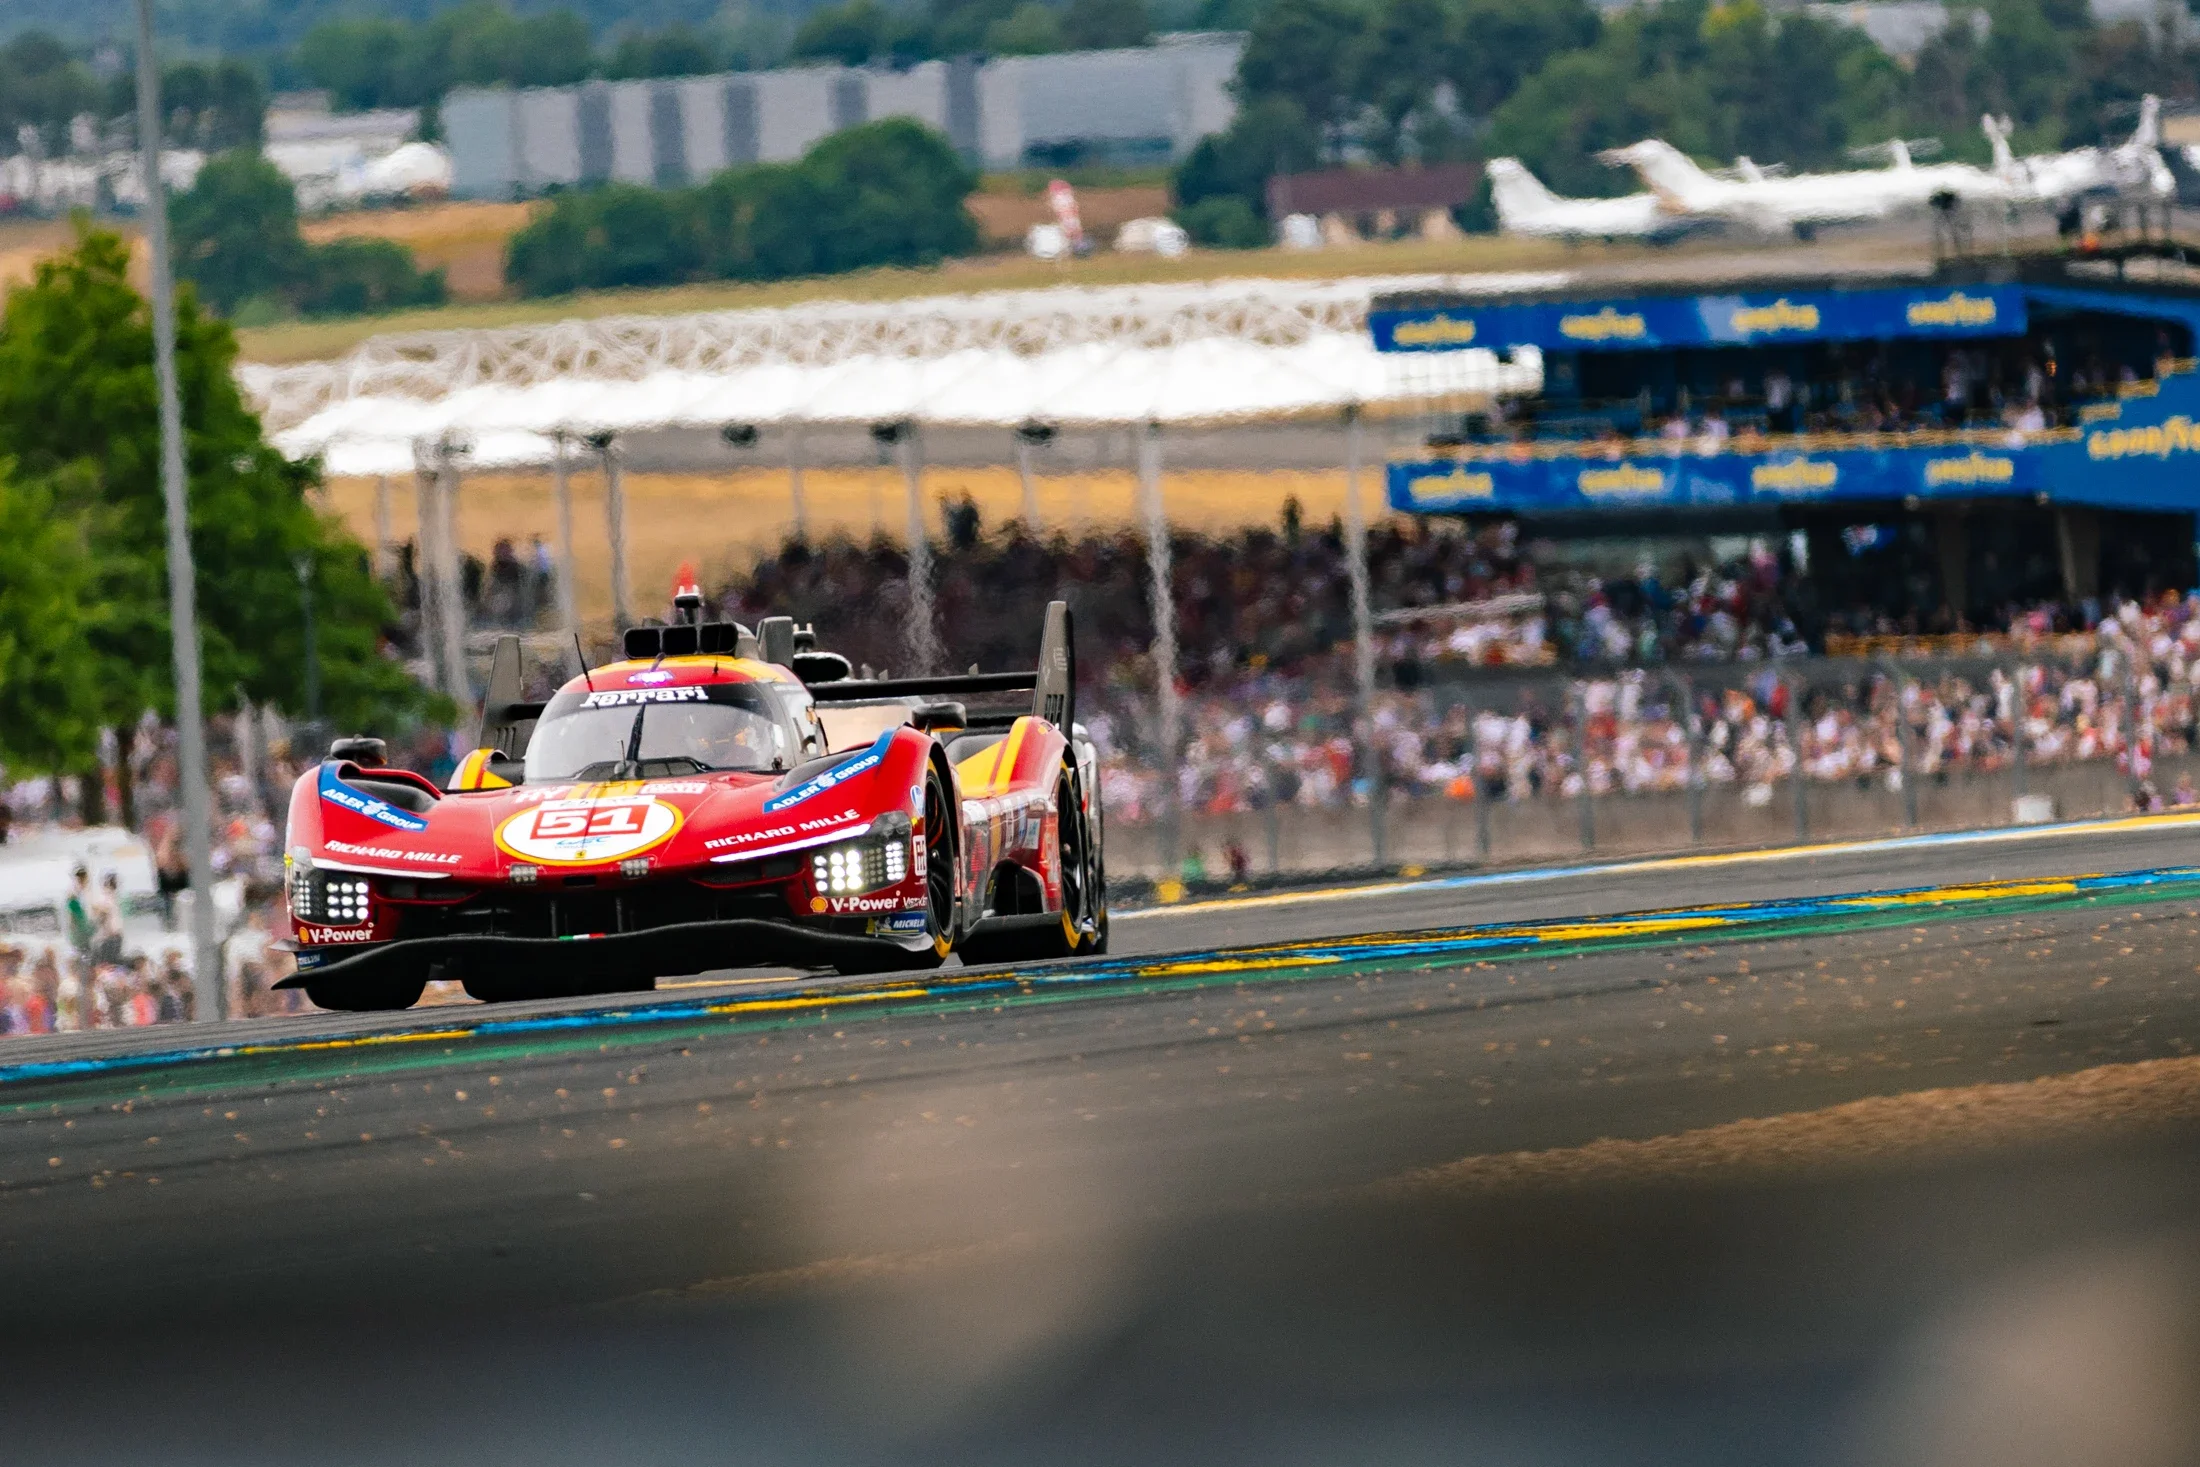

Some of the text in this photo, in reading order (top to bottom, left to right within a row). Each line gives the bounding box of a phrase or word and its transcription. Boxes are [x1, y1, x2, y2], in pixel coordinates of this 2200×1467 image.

[579, 686, 709, 708] Ferrari
[772, 754, 880, 811] ADLER GROUP
[321, 788, 424, 830] ADLER GROUP
[536, 807, 639, 837] 51
[704, 808, 861, 849] RICHARD MILLE
[323, 840, 463, 865] RICHARD MILLE
[830, 896, 899, 912] V-Power
[309, 927, 374, 944] V-Power
[893, 919, 926, 928] MICHELIN
